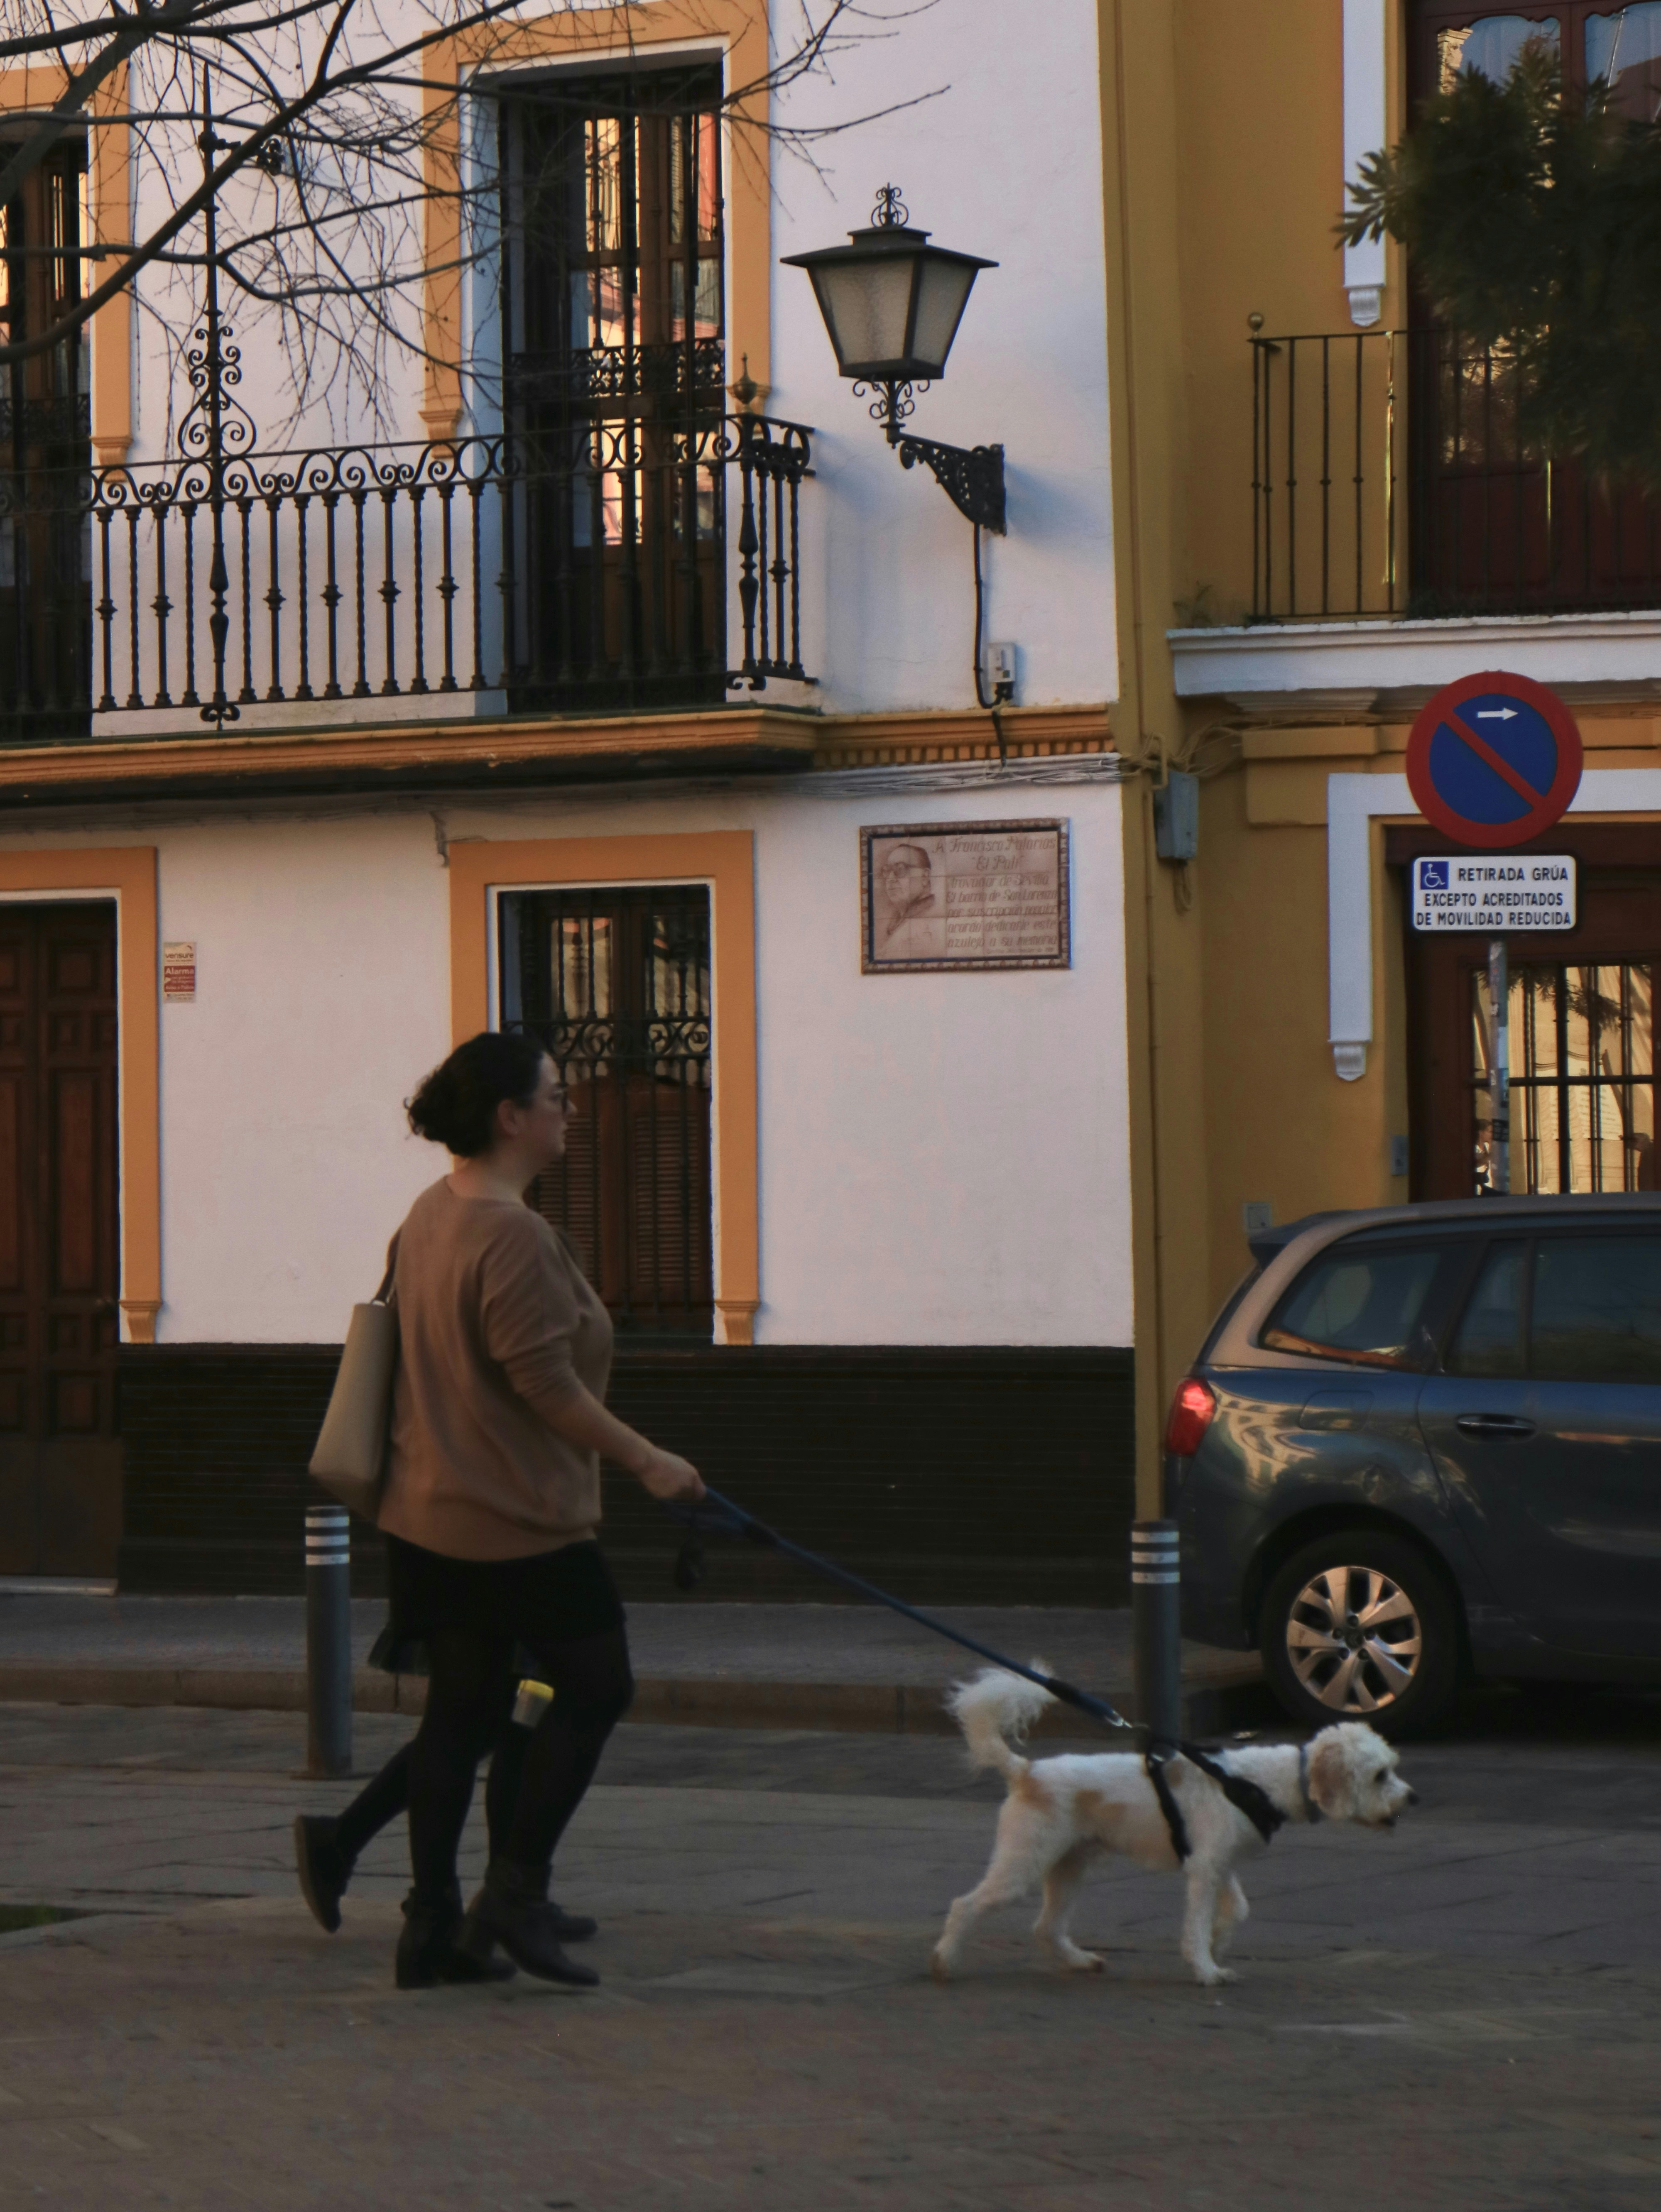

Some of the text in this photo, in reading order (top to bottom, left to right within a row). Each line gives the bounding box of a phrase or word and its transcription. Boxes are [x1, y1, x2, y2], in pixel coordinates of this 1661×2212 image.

[1458, 865, 1568, 881] RETIRADA GRÚA
[1425, 893, 1563, 906] EXCEPTO ACREDITADOS
[1417, 912, 1571, 925] DE MOVILIDAD REDUCIDA
